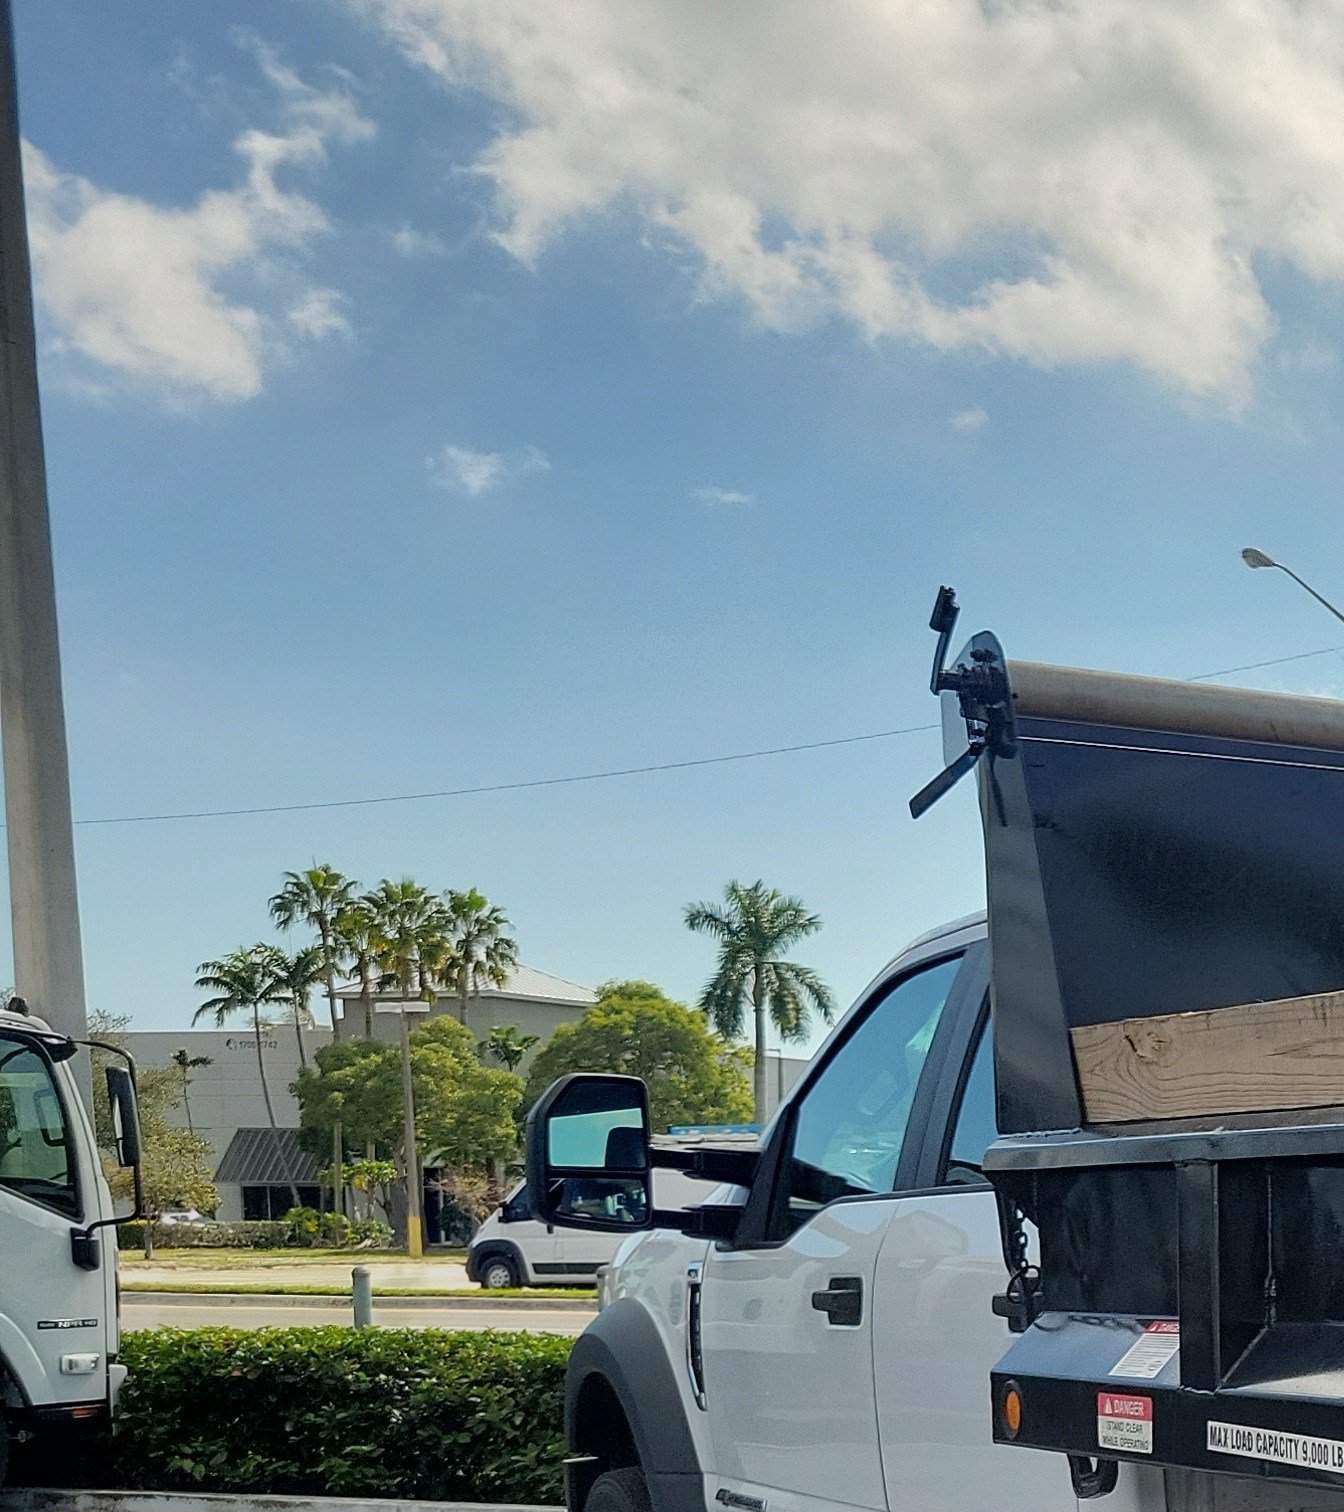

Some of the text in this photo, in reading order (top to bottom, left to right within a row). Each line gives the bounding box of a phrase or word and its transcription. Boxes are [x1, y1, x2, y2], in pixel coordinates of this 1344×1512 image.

[1113, 1399, 1144, 1416] DANGER
[1106, 1420, 1143, 1434] STAND CLEAR
[1209, 1425, 1229, 1448] MAX
[1230, 1429, 1254, 1453] LOAD
[1256, 1432, 1300, 1460] CAPACITY
[1301, 1440, 1329, 1466] 9,000
